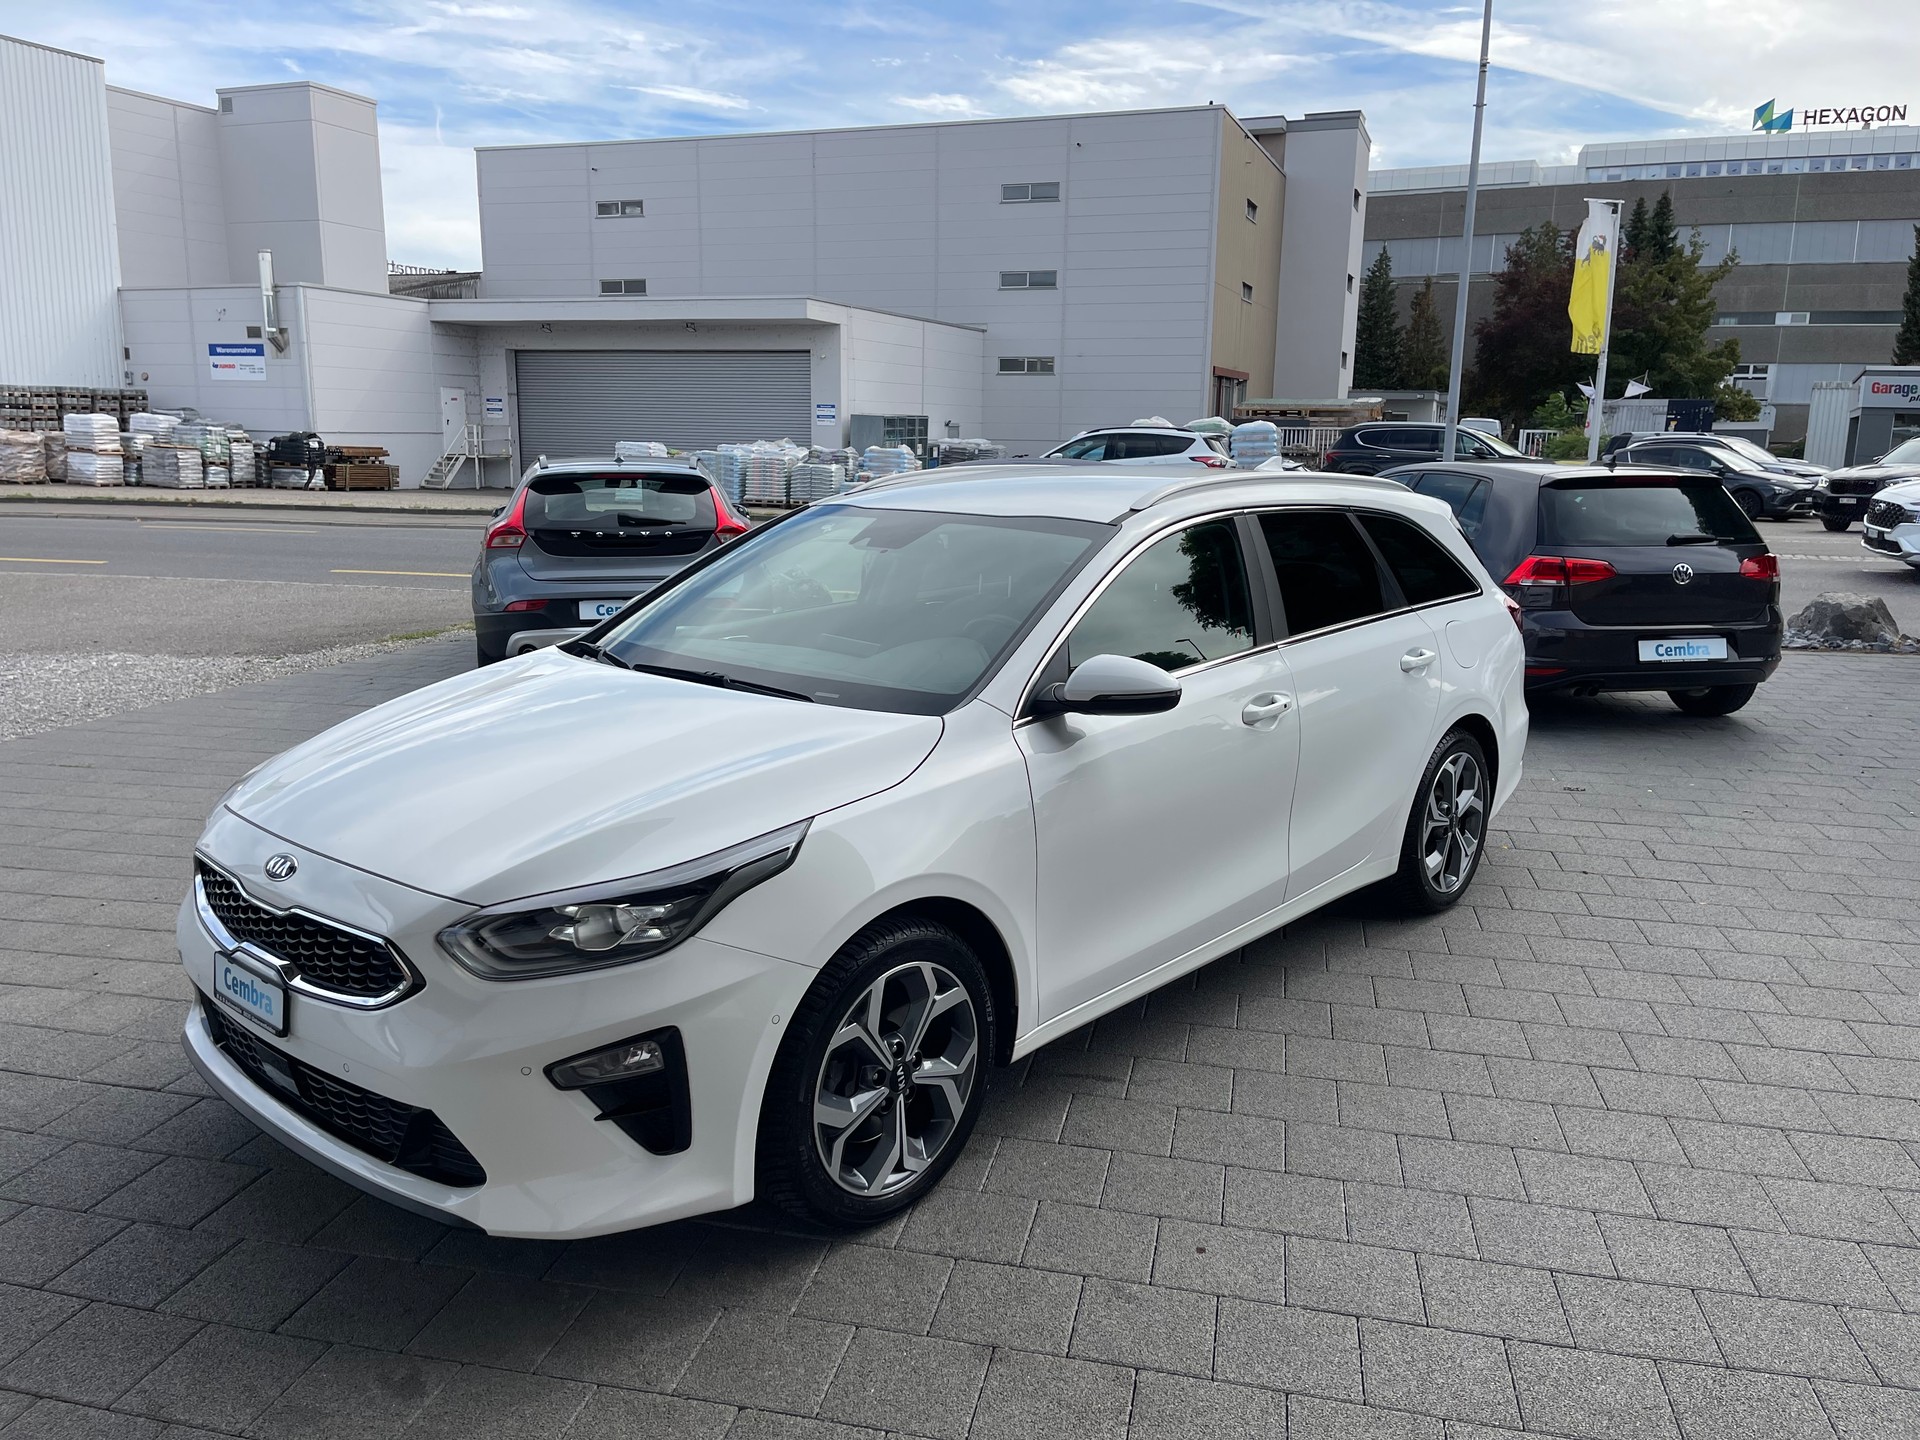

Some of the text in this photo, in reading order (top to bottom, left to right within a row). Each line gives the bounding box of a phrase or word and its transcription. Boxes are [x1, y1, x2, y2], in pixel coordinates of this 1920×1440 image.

[1803, 104, 1908, 126] HEXAGON
[215, 346, 257, 354] Warenannahme
[1871, 381, 1919, 398] Garage
[1908, 394, 1920, 403] pl
[1654, 641, 1711, 657] Cembra
[266, 855, 291, 877] KIA
[223, 966, 274, 1017] Cembra
